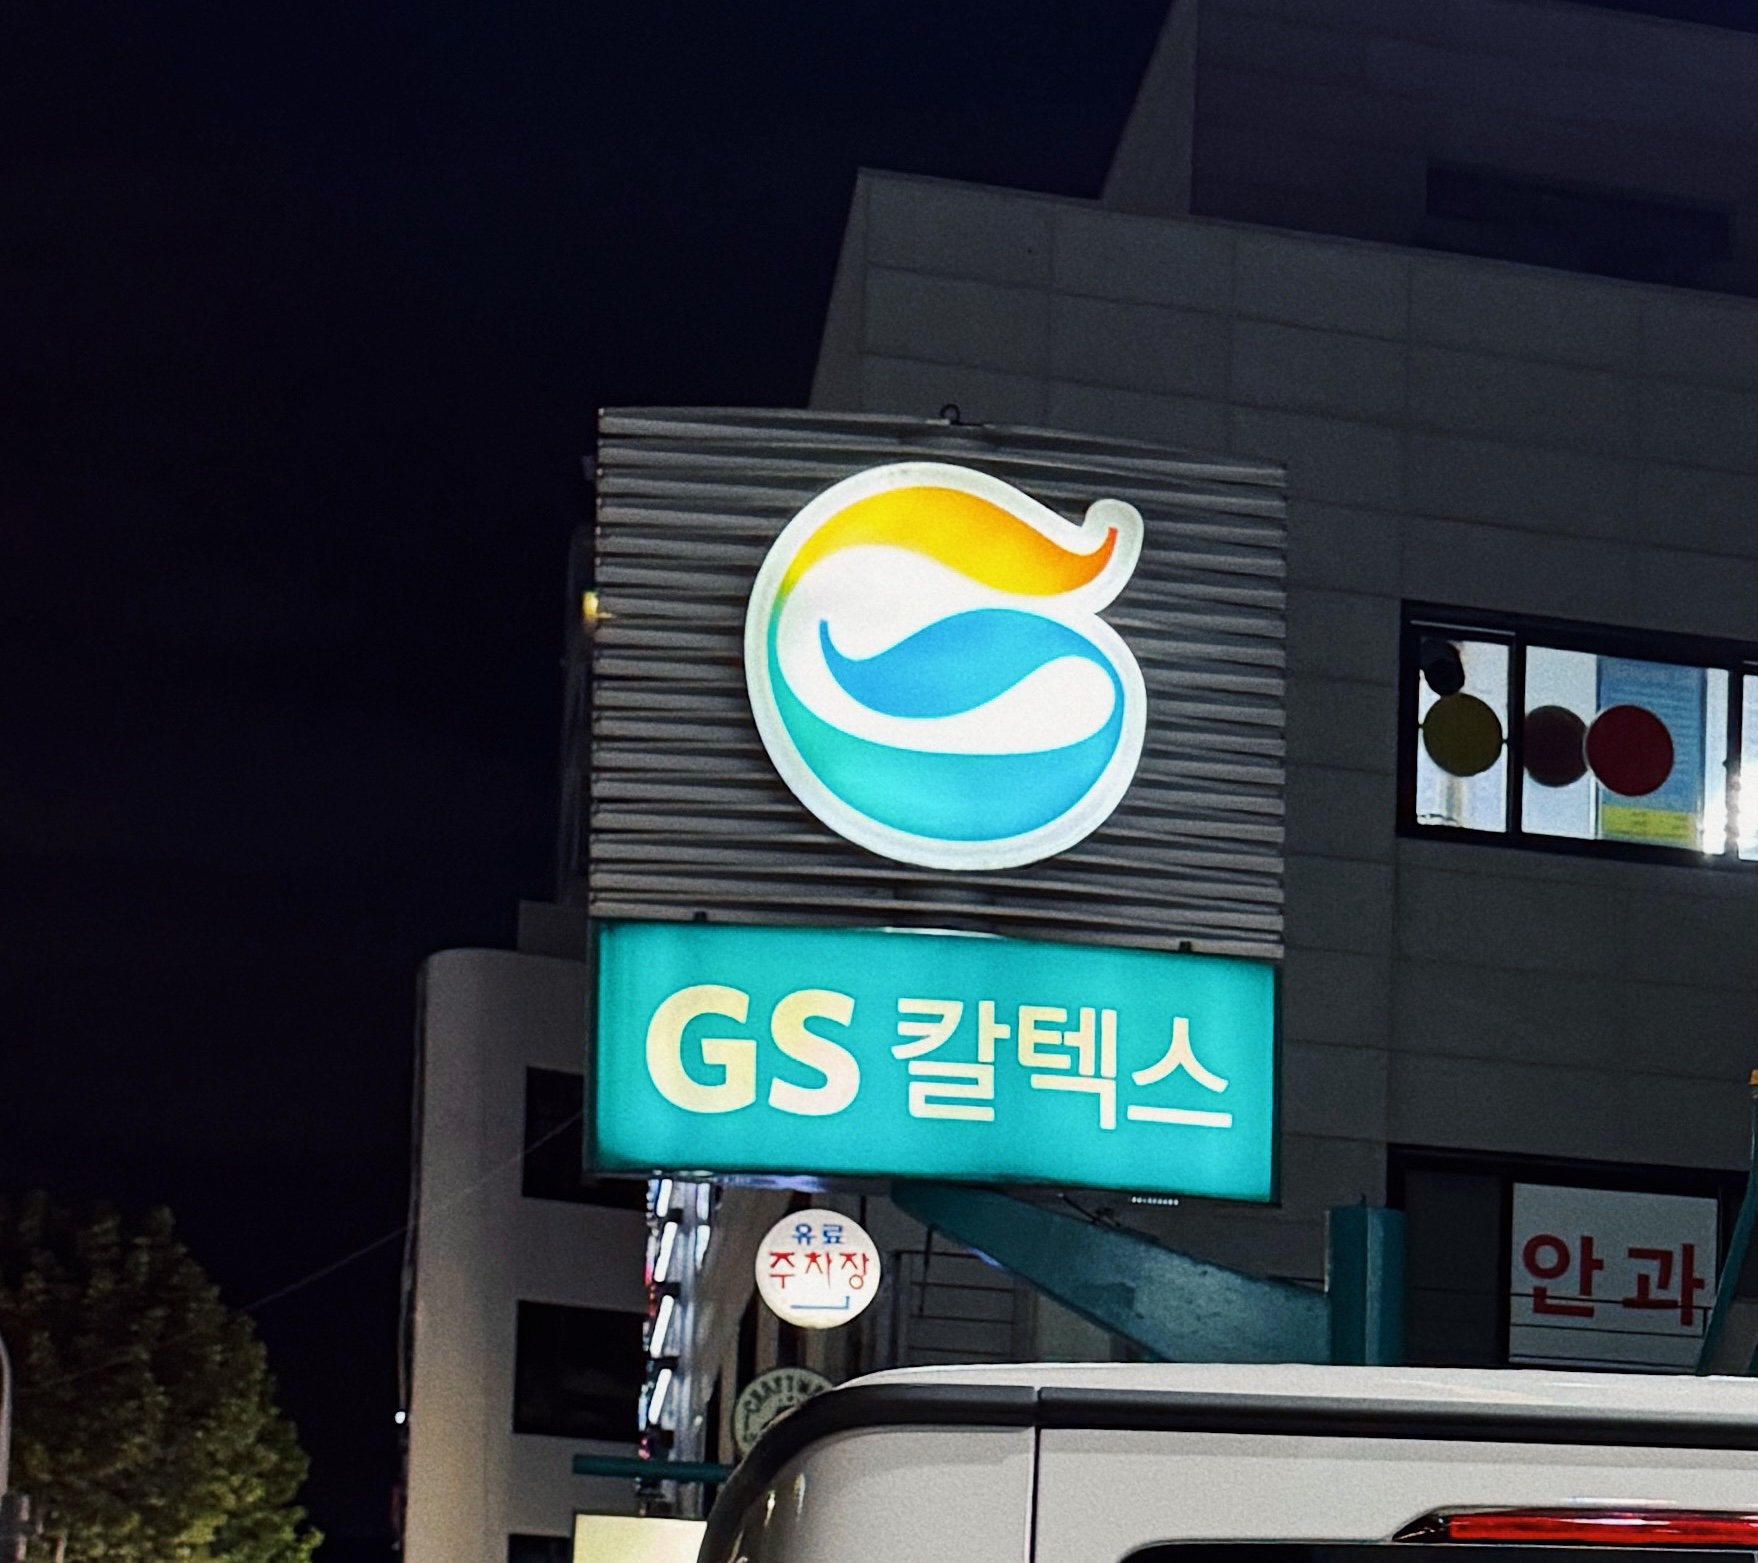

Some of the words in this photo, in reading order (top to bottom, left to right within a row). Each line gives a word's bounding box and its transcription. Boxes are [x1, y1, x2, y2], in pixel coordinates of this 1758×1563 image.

[645, 984, 861, 1116] GS
[892, 996, 1233, 1131] 칼텍스
[792, 1223, 844, 1246] 유료
[769, 1251, 870, 1290] 주차장
[1522, 1232, 1705, 1326] 안과
